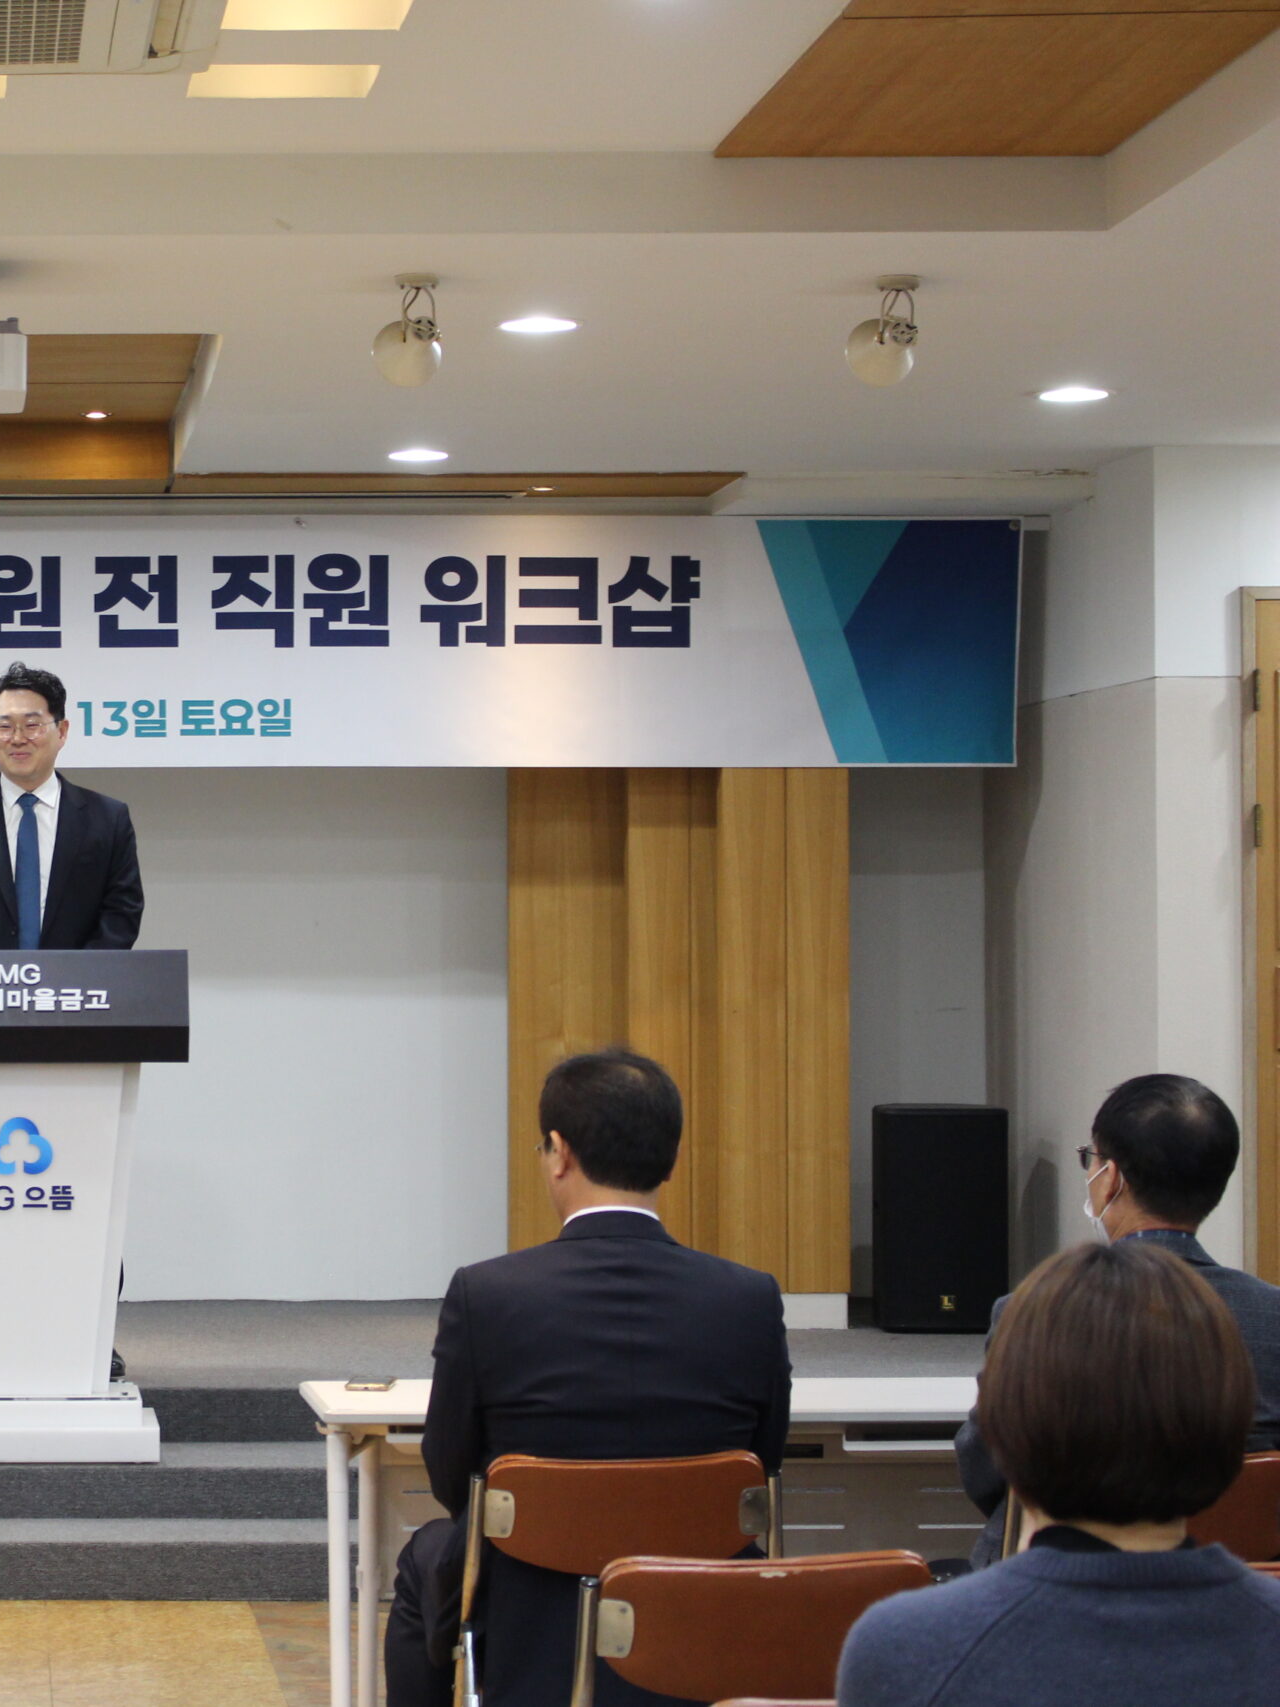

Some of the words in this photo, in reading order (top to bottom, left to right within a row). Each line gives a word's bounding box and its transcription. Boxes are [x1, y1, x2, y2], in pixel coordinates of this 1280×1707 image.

[93, 555, 180, 648] 전
[211, 553, 390, 648] 직원
[419, 554, 701, 648] 워크샵
[77, 699, 167, 738] 13일
[179, 698, 292, 738] 토요일
[22, 1185, 75, 1211] 으뜸
